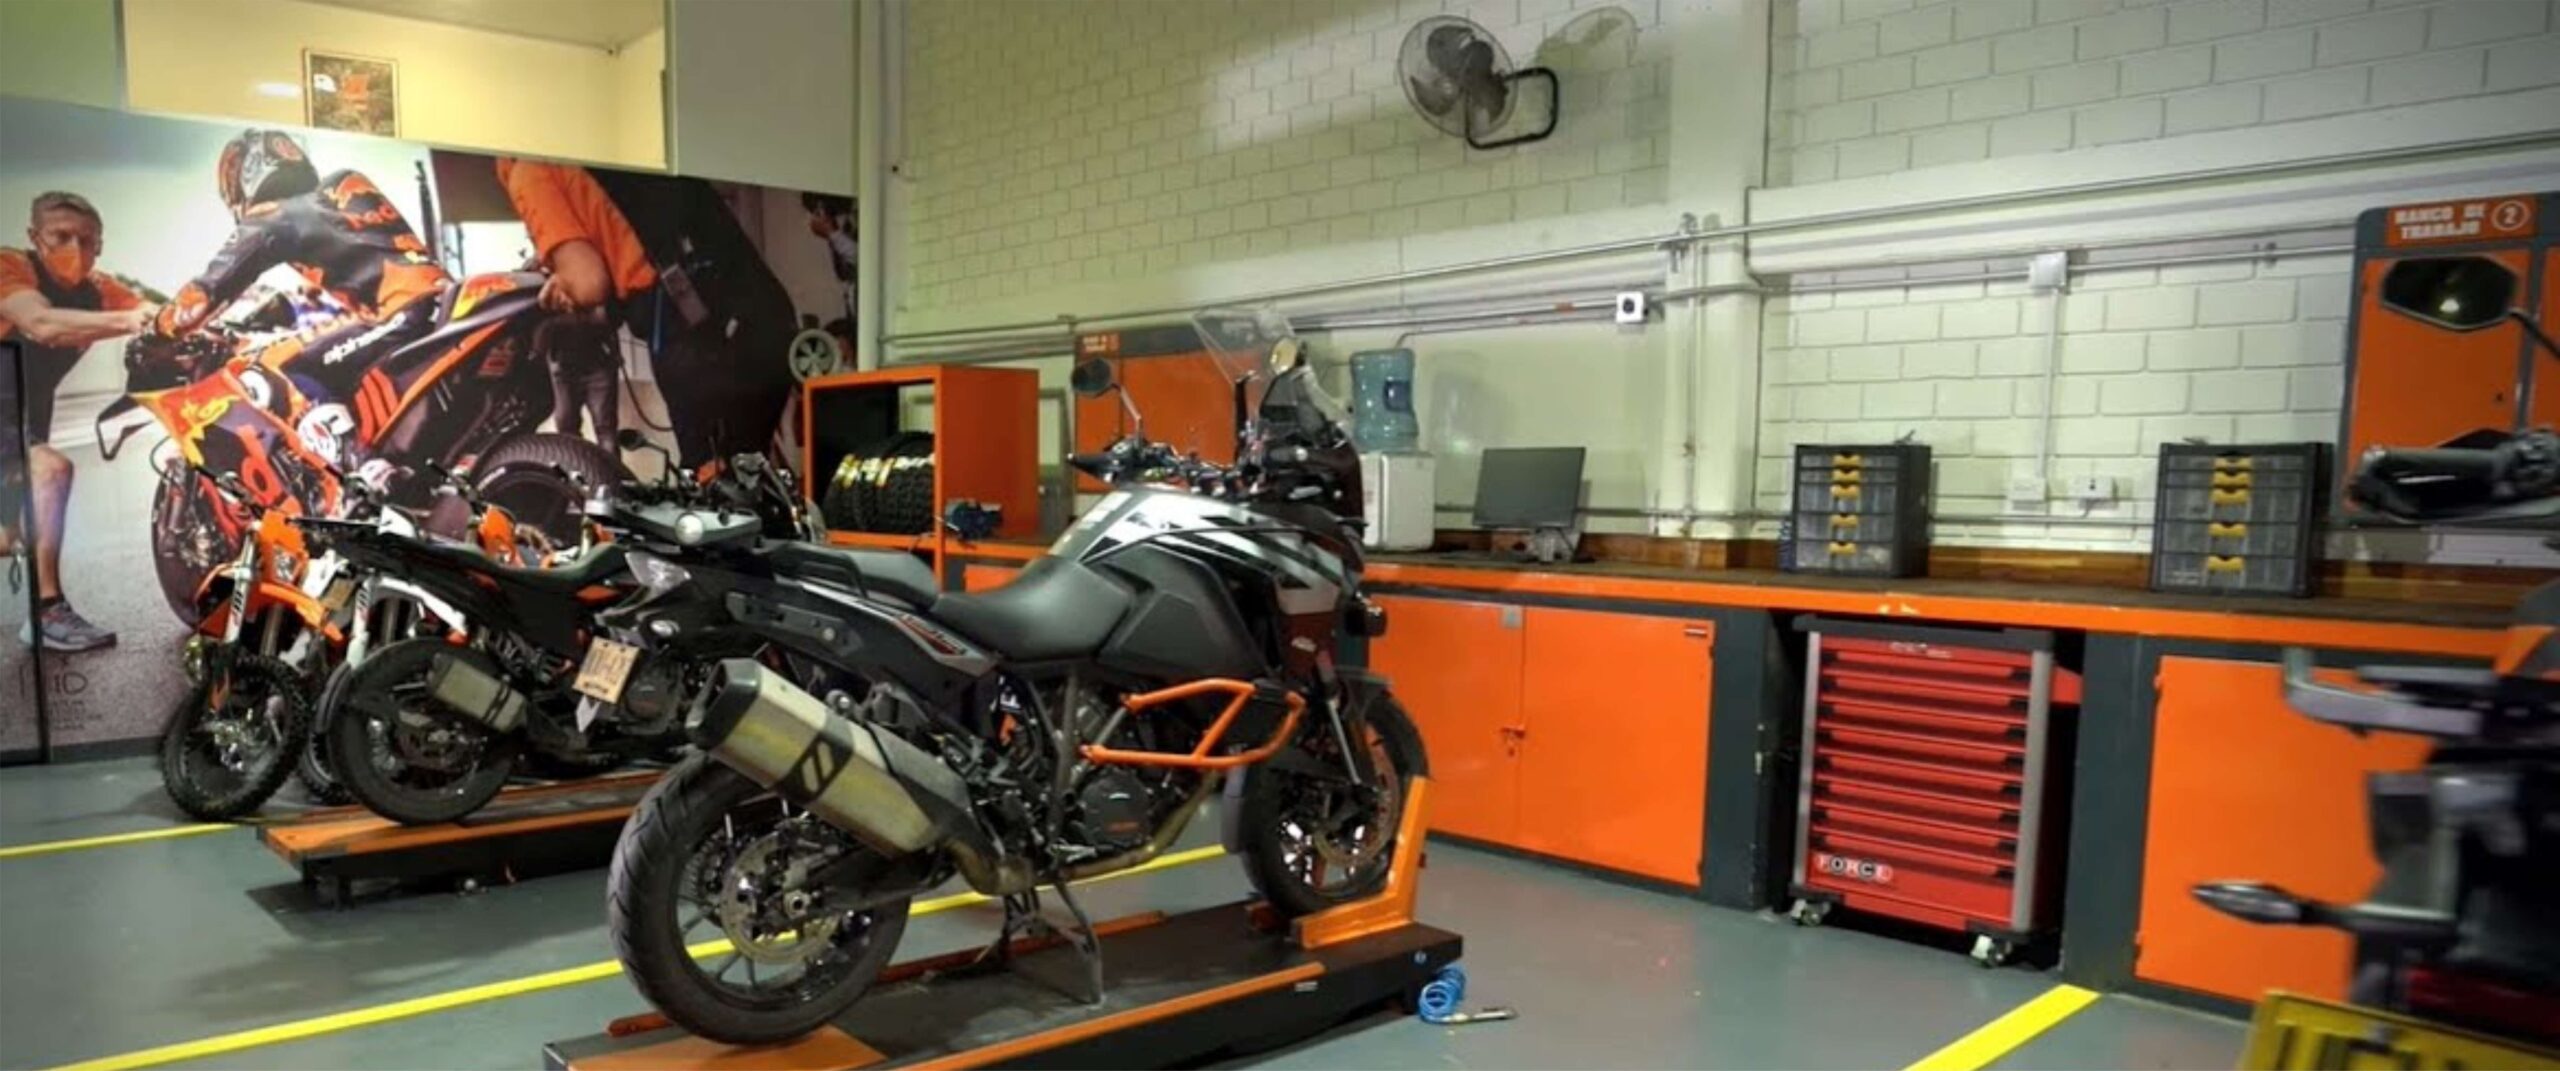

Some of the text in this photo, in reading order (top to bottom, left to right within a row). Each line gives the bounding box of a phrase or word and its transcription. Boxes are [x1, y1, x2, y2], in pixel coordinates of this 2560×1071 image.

[2394, 203, 2518, 225] BANCO DE 2
[2400, 220, 2480, 240] TRABAJO
[1813, 853, 1893, 883] FORCE
